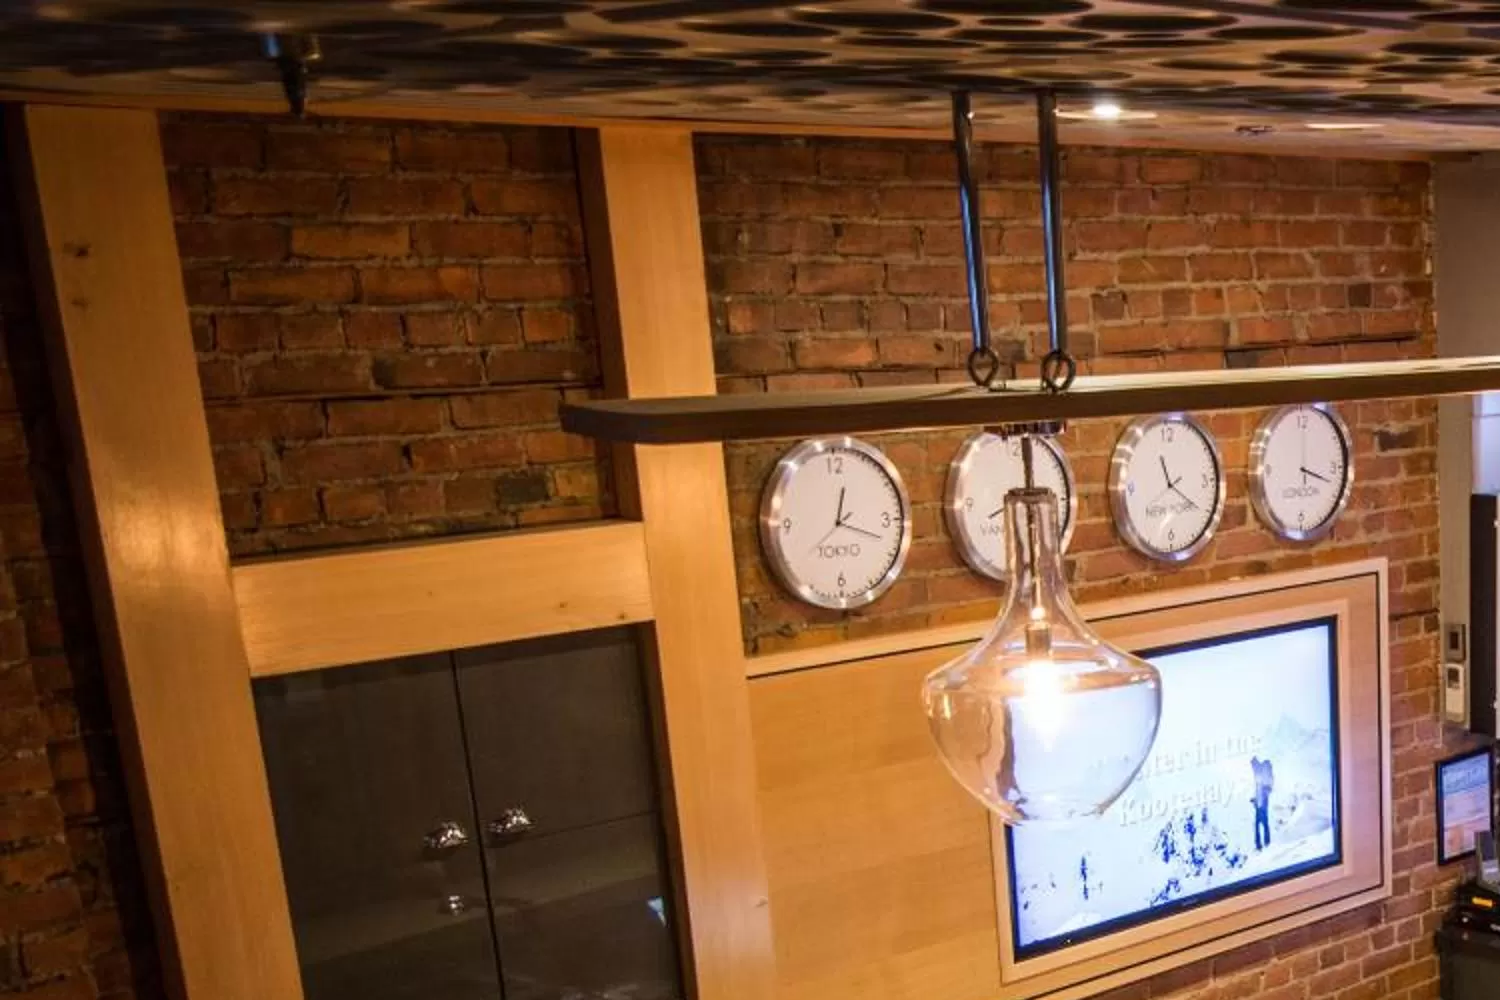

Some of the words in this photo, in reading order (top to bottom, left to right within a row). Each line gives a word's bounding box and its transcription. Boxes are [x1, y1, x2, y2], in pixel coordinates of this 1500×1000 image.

[1160, 427, 1174, 443] 12
[826, 456, 844, 475] 12
[783, 517, 793, 536] 9
[880, 511, 891, 529] 3
[1167, 528, 1175, 542] 6
[815, 542, 862, 559] TOKYO
[837, 570, 847, 588] 6
